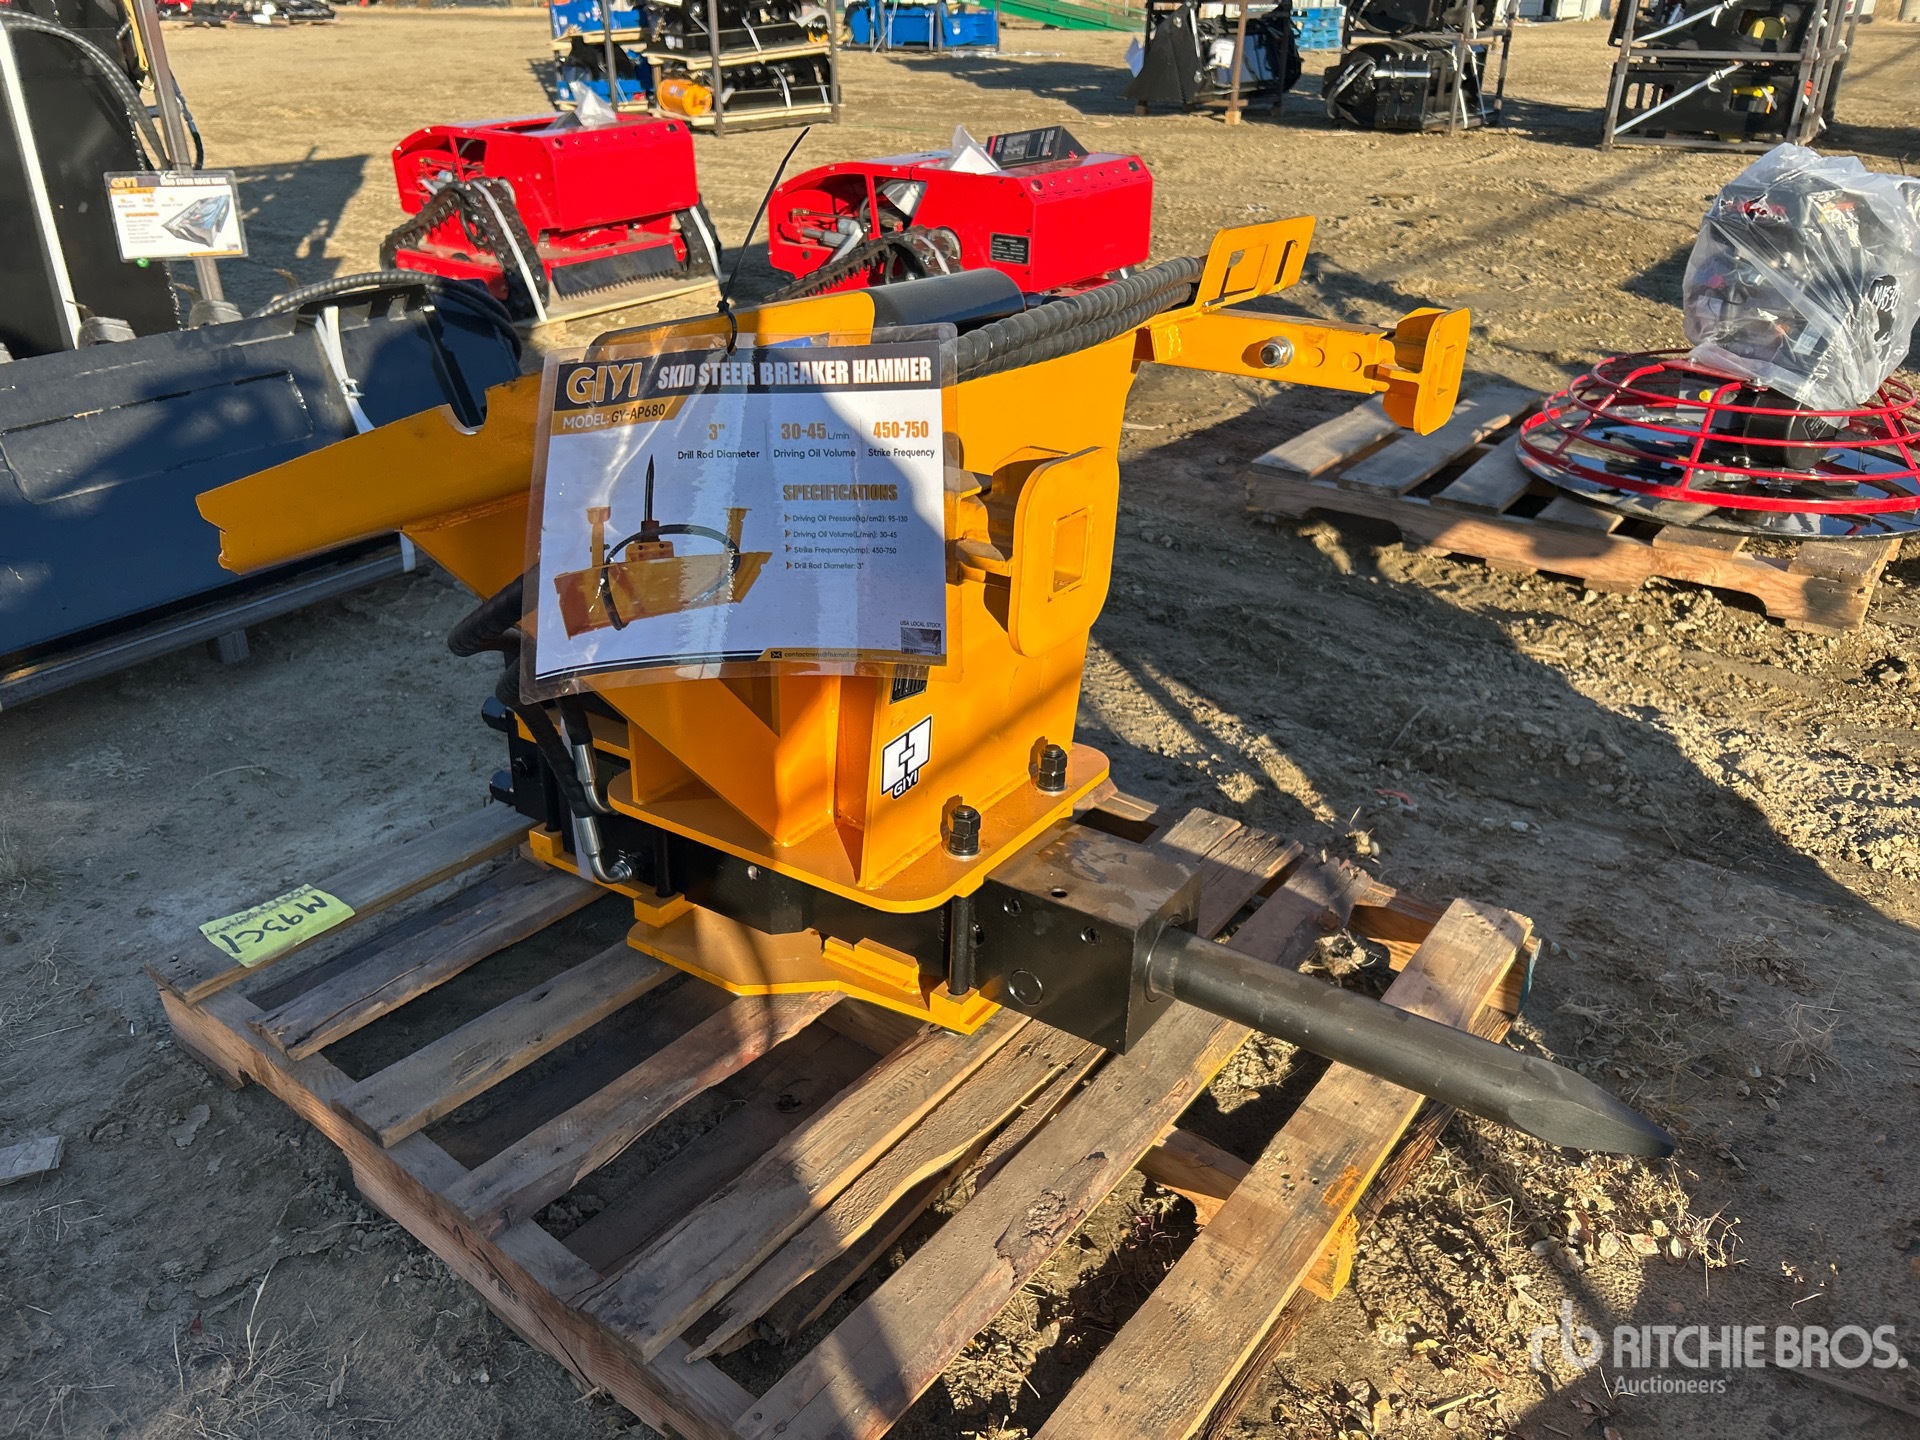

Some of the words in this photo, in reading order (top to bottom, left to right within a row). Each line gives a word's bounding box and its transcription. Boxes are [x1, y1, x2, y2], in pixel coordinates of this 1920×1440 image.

[658, 365, 696, 390] SKID
[698, 362, 755, 386] STEER
[759, 360, 849, 386] BREAKER
[852, 357, 932, 384] HAMMER
[566, 362, 643, 405] GIYI
[562, 413, 610, 430] MODEL:
[611, 403, 666, 423] GY-AP680
[780, 422, 827, 440] 30-45
[827, 431, 850, 441] L/min
[873, 420, 930, 439] 450-750
[677, 450, 694, 460] Drill
[697, 450, 714, 460] Rod
[716, 449, 760, 459] Diameter
[773, 449, 806, 460] Driving
[808, 448, 821, 458] Oil
[822, 448, 856, 458] Volume
[868, 448, 891, 458] Strike
[893, 448, 935, 459] Frequency
[783, 484, 898, 501] SPECIFICATIONS
[792, 515, 816, 523] Driving
[817, 514, 827, 522] Oil
[887, 515, 908, 523] 95-130
[793, 531, 817, 539] Driving
[879, 531, 898, 539] 30-45
[793, 546, 813, 554] Strike
[871, 547, 897, 555] 450-750
[893, 769, 918, 797] GIYI
